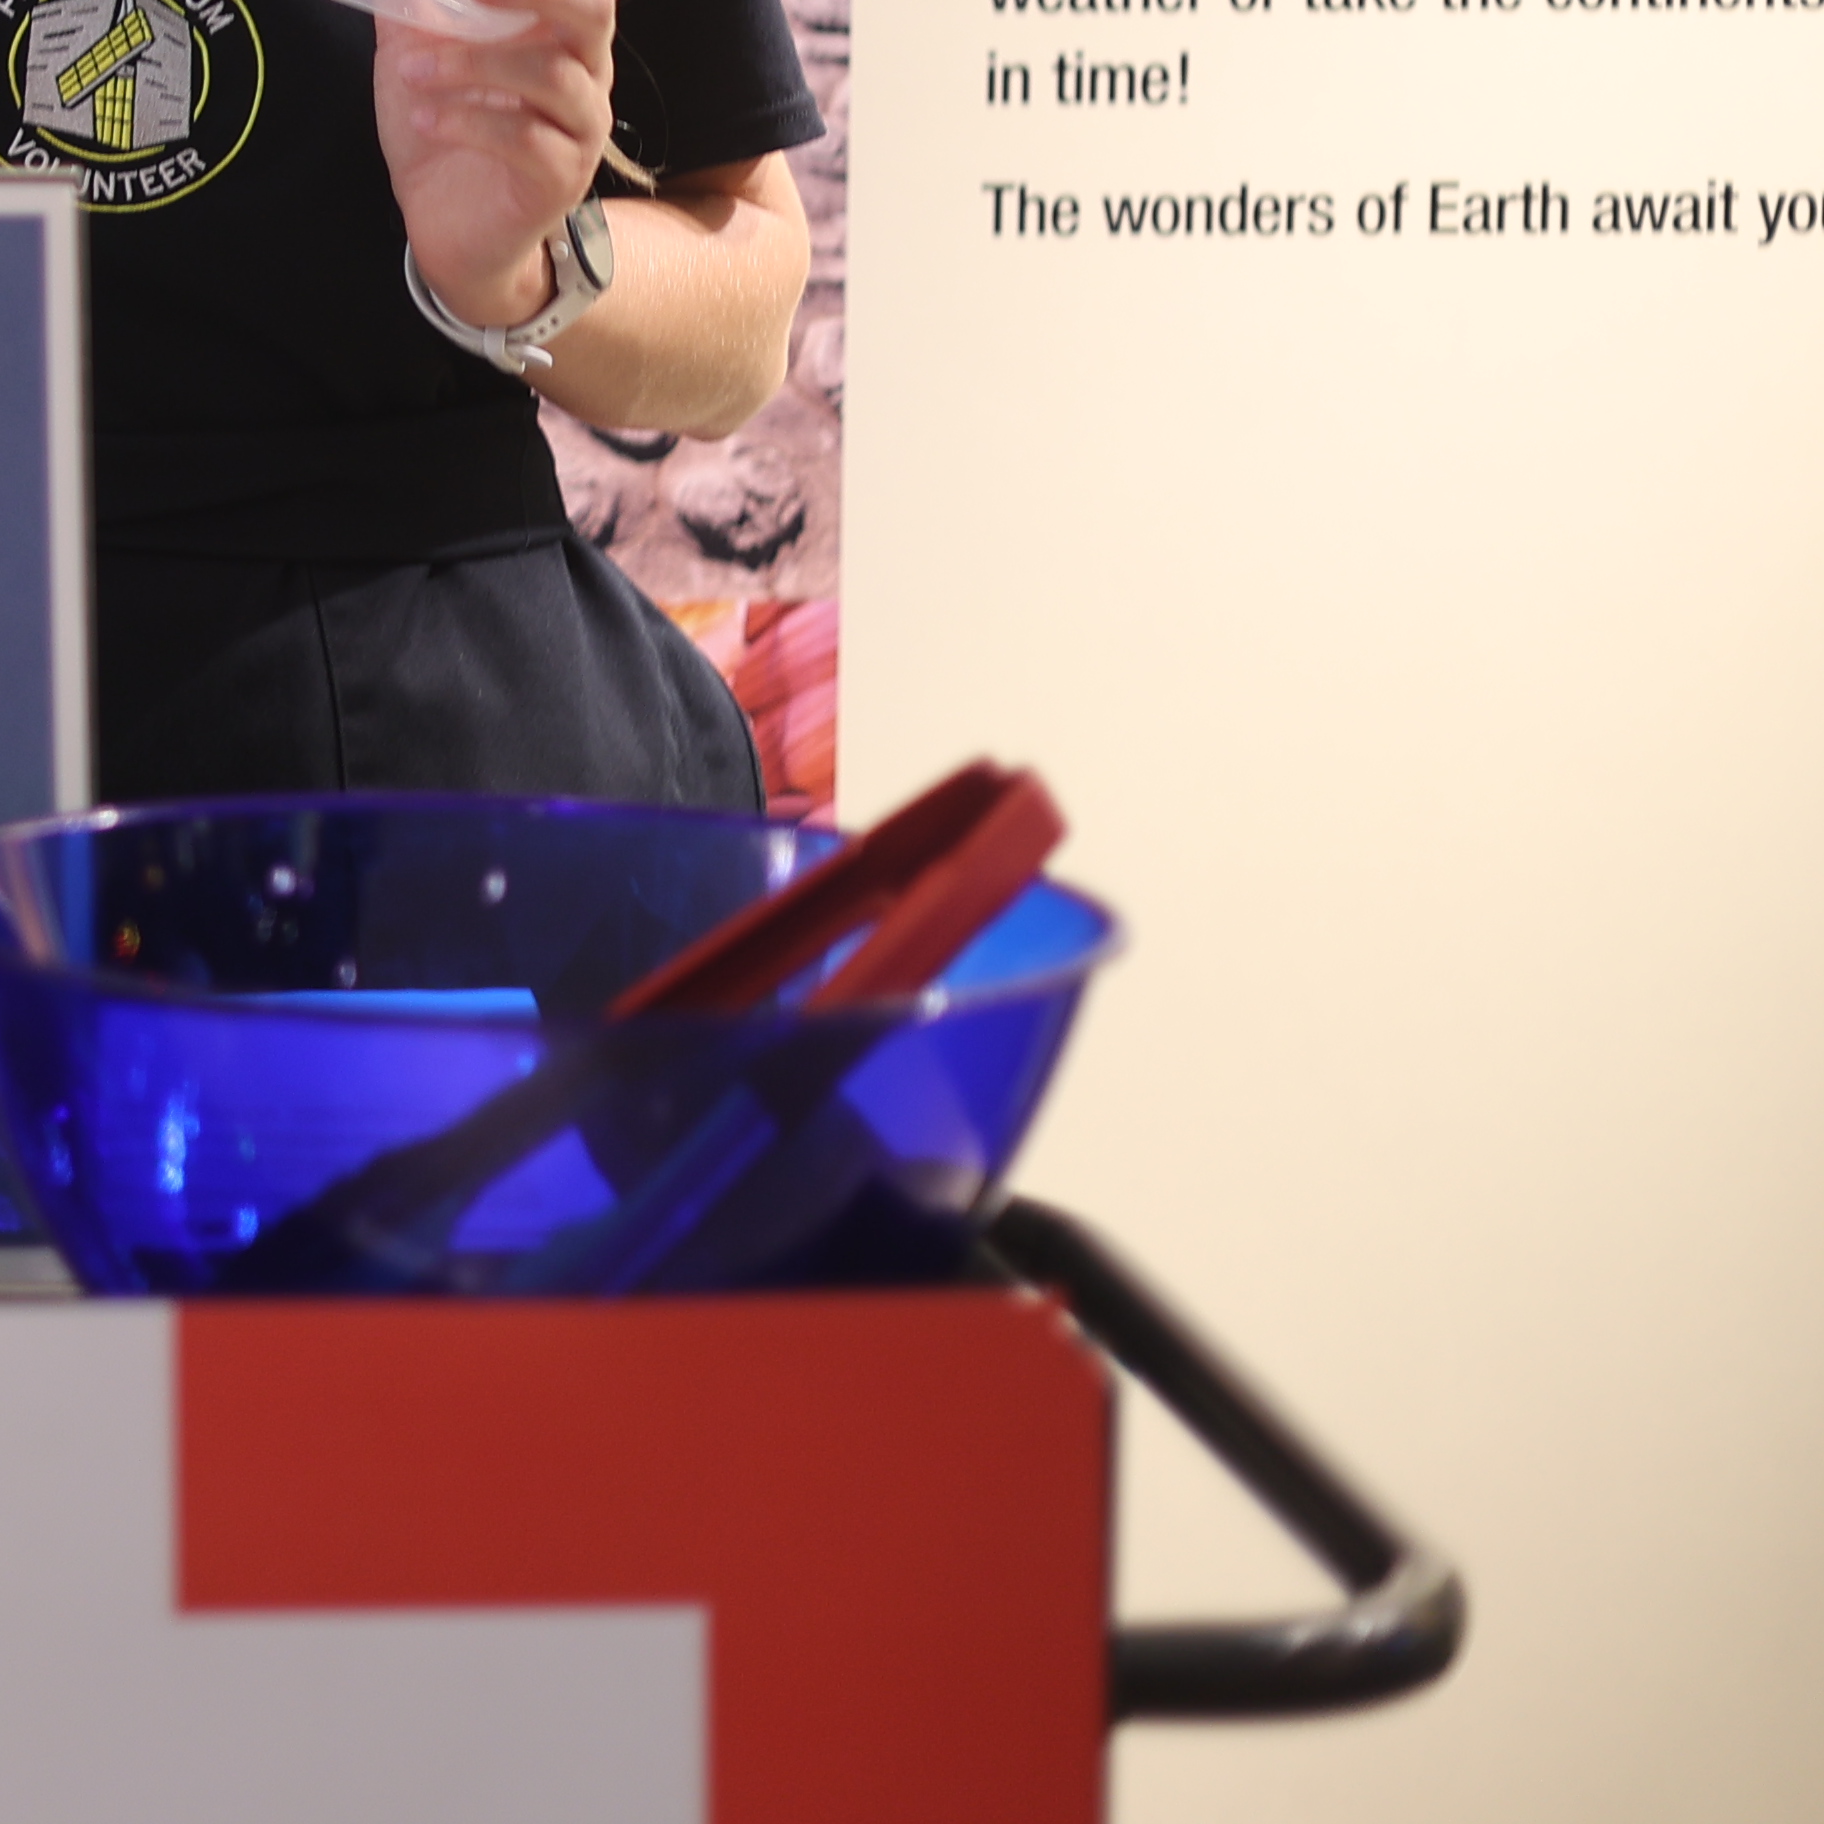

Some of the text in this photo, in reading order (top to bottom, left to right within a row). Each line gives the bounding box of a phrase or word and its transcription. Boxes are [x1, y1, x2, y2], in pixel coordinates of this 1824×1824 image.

[987, 50, 1189, 105] in time!
[985, 181, 1824, 244] The wonders of Earth await yo
